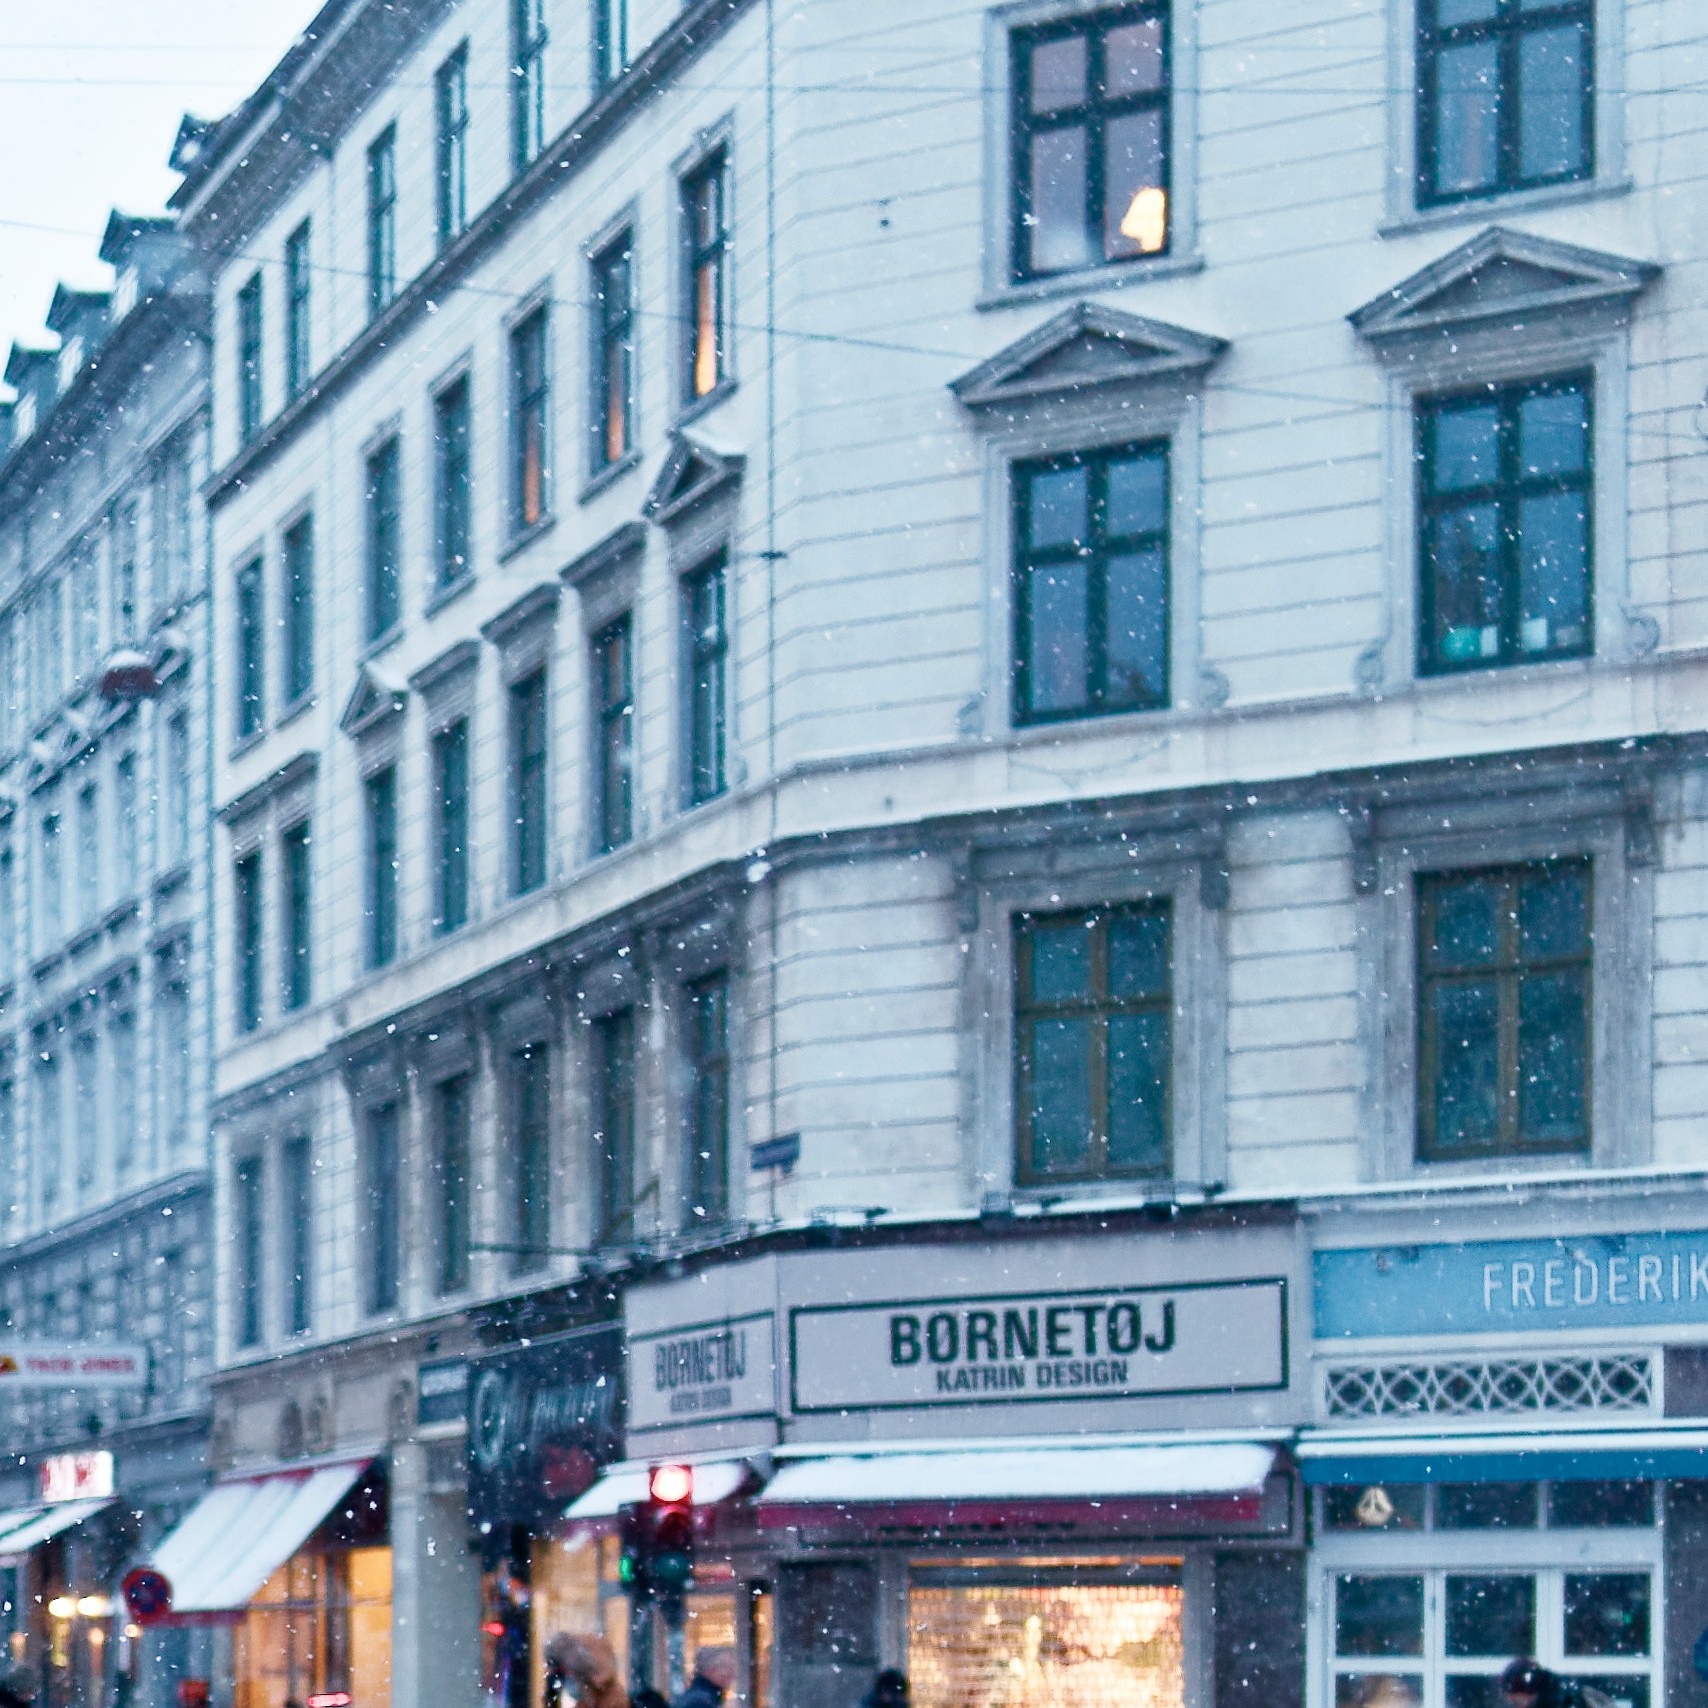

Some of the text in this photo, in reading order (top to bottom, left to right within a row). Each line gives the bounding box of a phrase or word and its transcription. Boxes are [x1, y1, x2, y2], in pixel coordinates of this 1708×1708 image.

[1483, 1252, 1708, 1314] FREDERIK
[936, 1358, 1129, 1393] KATRIN DESIGN
